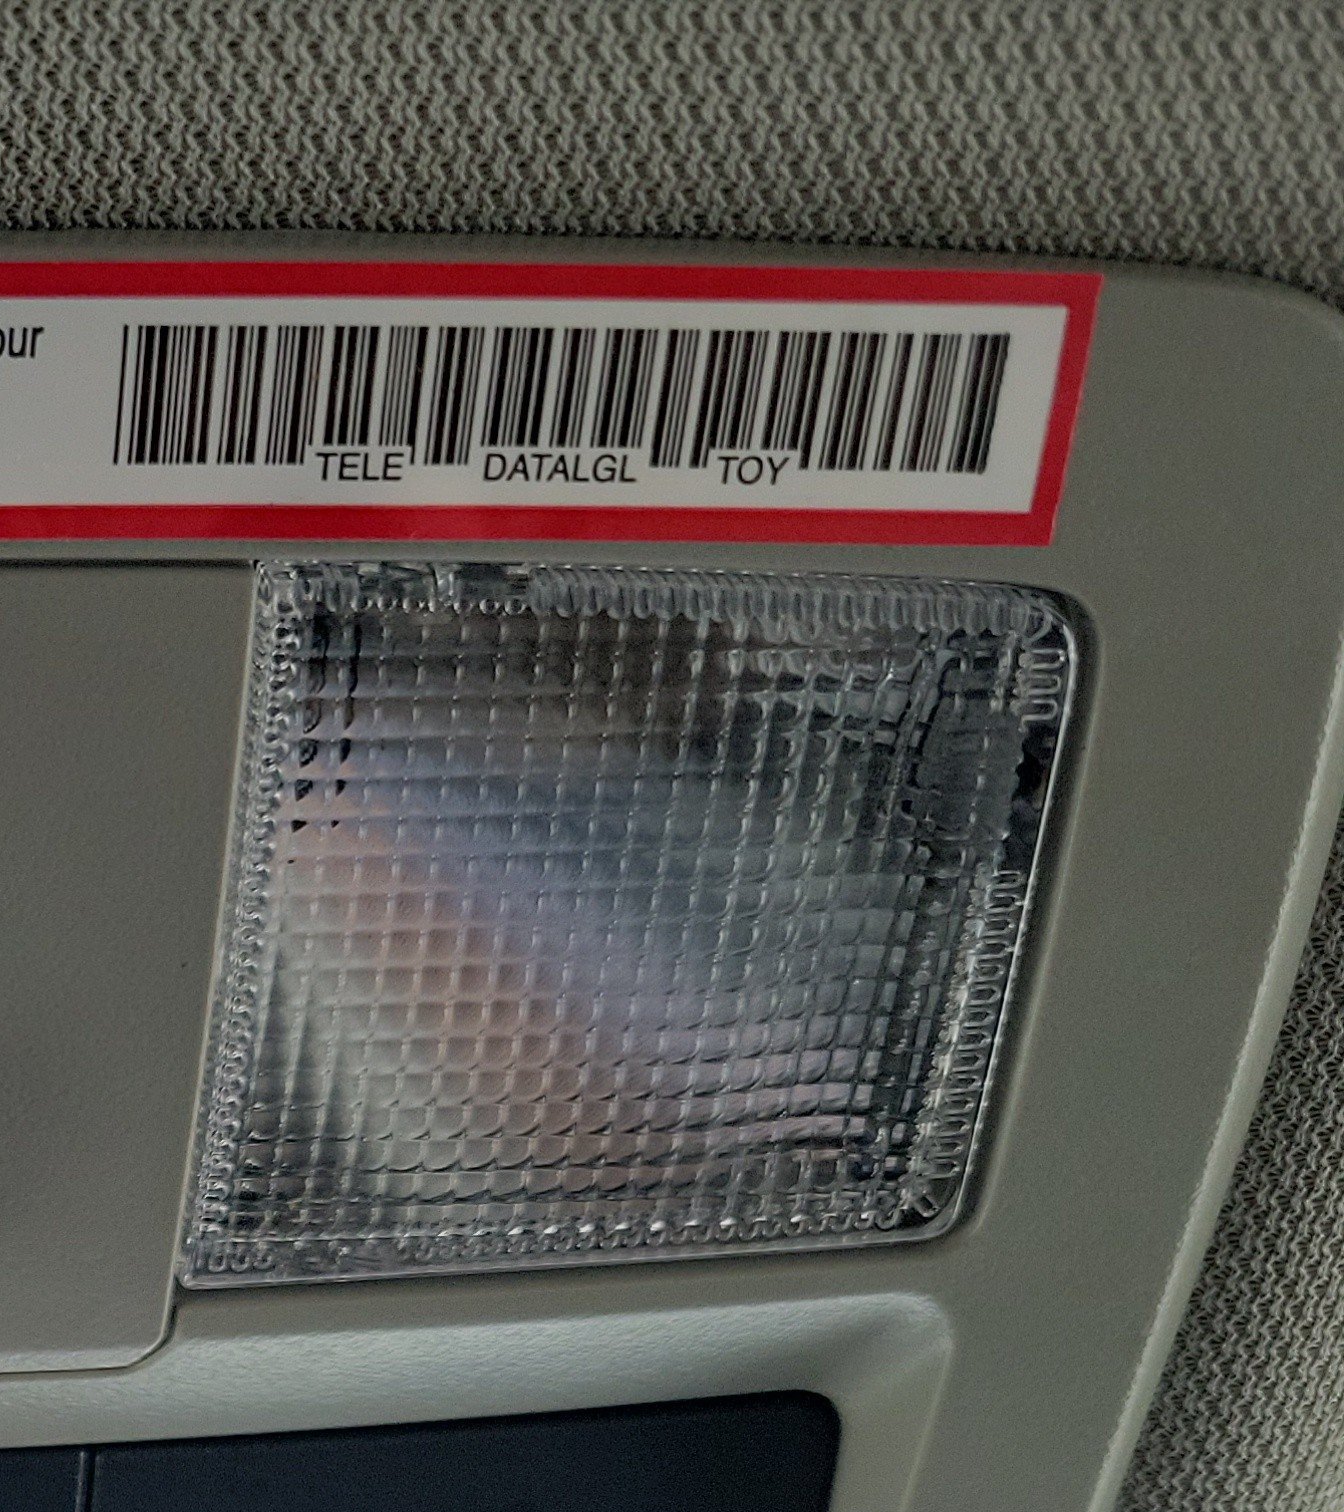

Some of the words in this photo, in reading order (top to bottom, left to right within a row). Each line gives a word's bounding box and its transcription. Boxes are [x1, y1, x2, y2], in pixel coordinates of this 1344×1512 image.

[315, 449, 405, 485] TELE
[480, 447, 638, 486] DATALGL
[717, 448, 791, 488] TOY
